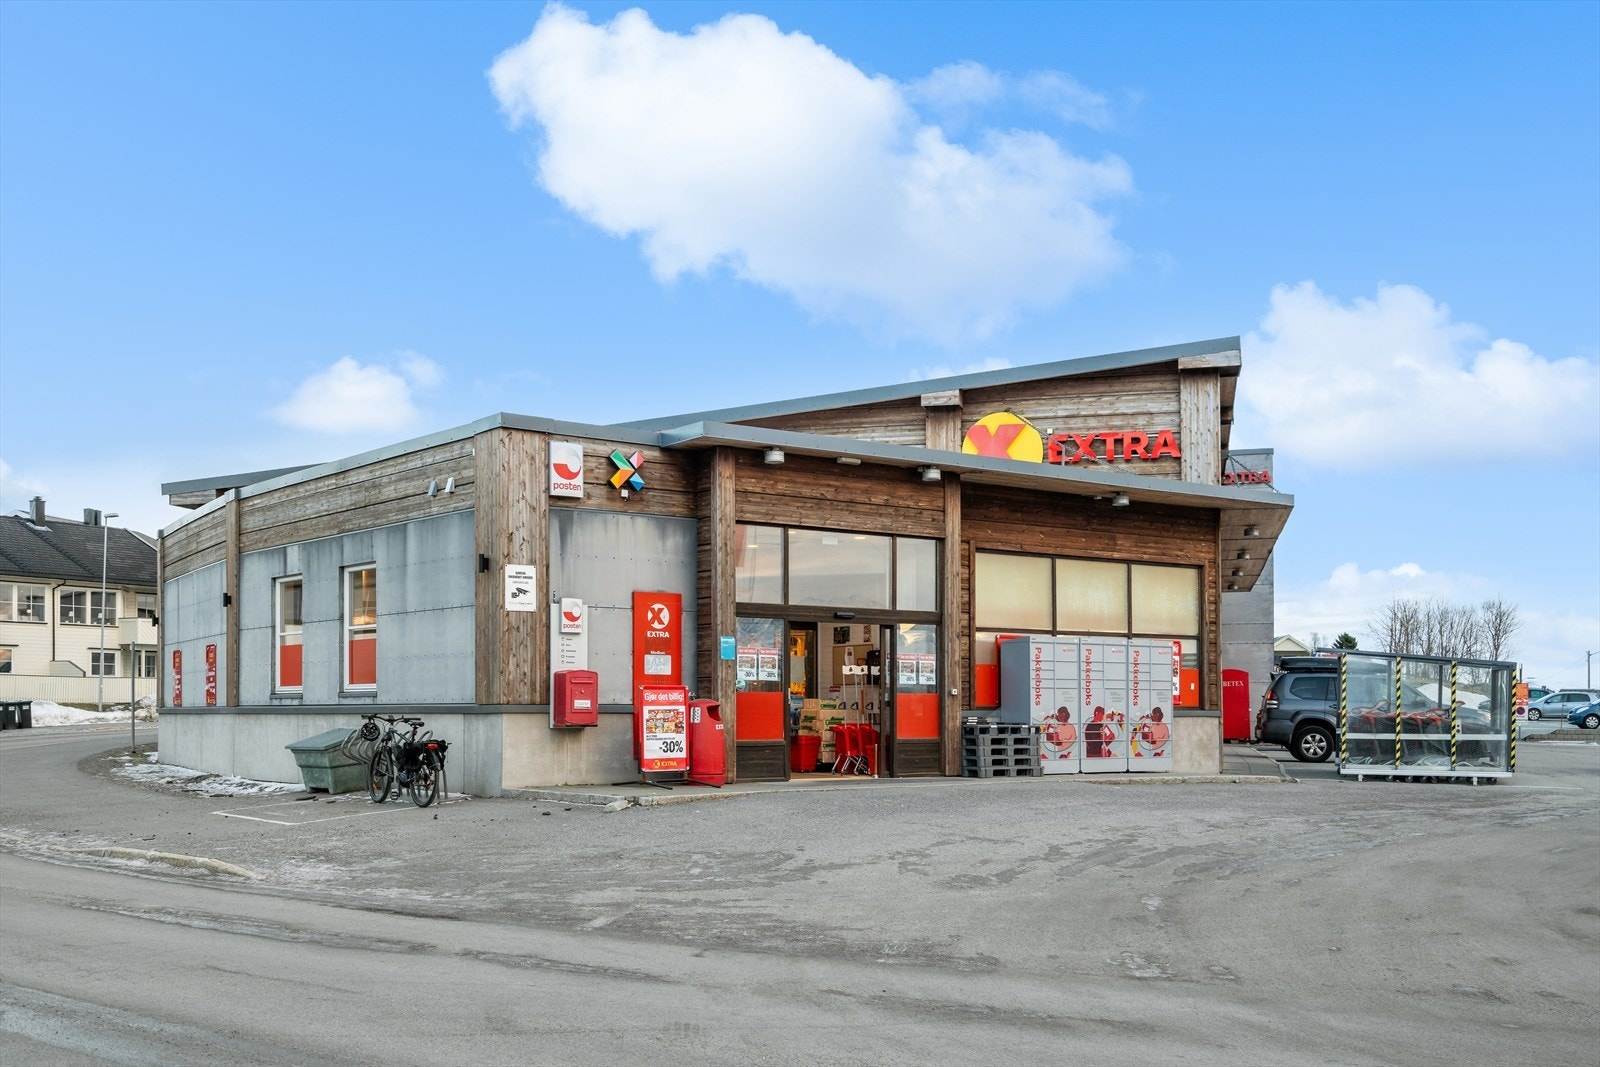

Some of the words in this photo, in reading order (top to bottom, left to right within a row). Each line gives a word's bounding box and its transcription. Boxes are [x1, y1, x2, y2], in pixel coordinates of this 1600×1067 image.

[1048, 430, 1181, 463] EXTRA
[553, 481, 582, 491] posten
[1034, 647, 1042, 706] Pakkeboks
[1085, 648, 1093, 706] Pakkeboks
[1132, 650, 1140, 706] Pakkeboks
[644, 692, 657, 702] Gjør
[658, 692, 668, 700] det
[659, 740, 684, 753] -30%
